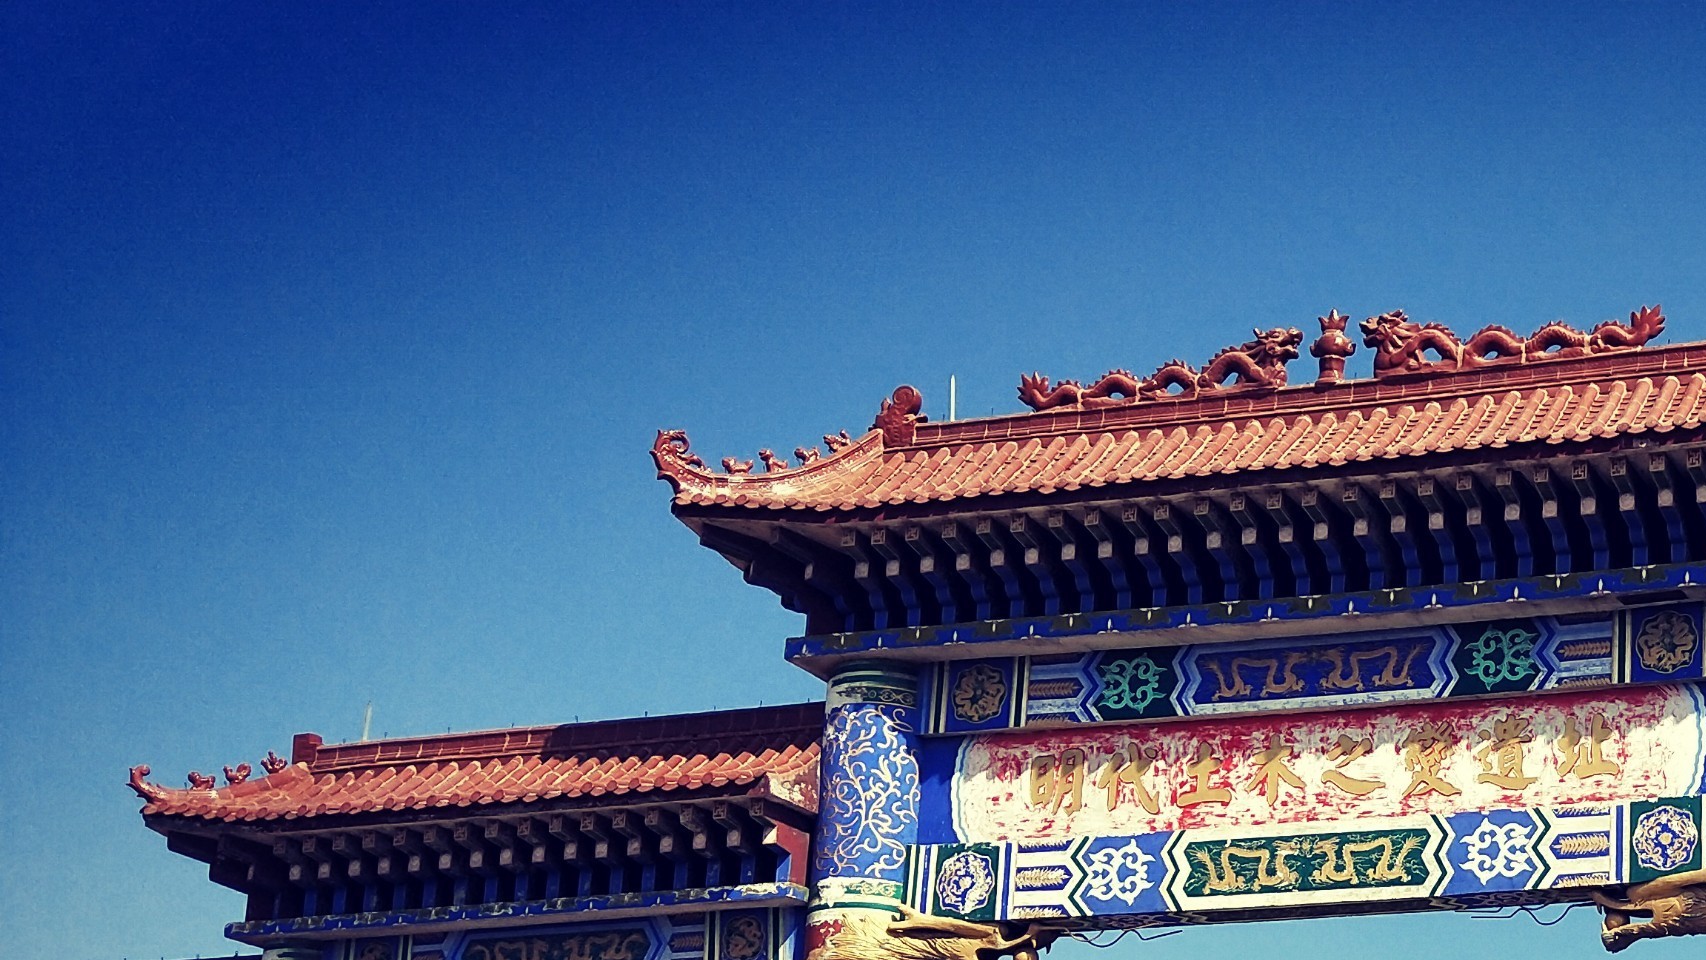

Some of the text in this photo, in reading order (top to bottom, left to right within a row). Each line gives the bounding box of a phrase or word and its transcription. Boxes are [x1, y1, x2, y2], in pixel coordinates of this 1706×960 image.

[1030, 714, 1620, 815] 明代土木之變遺址
